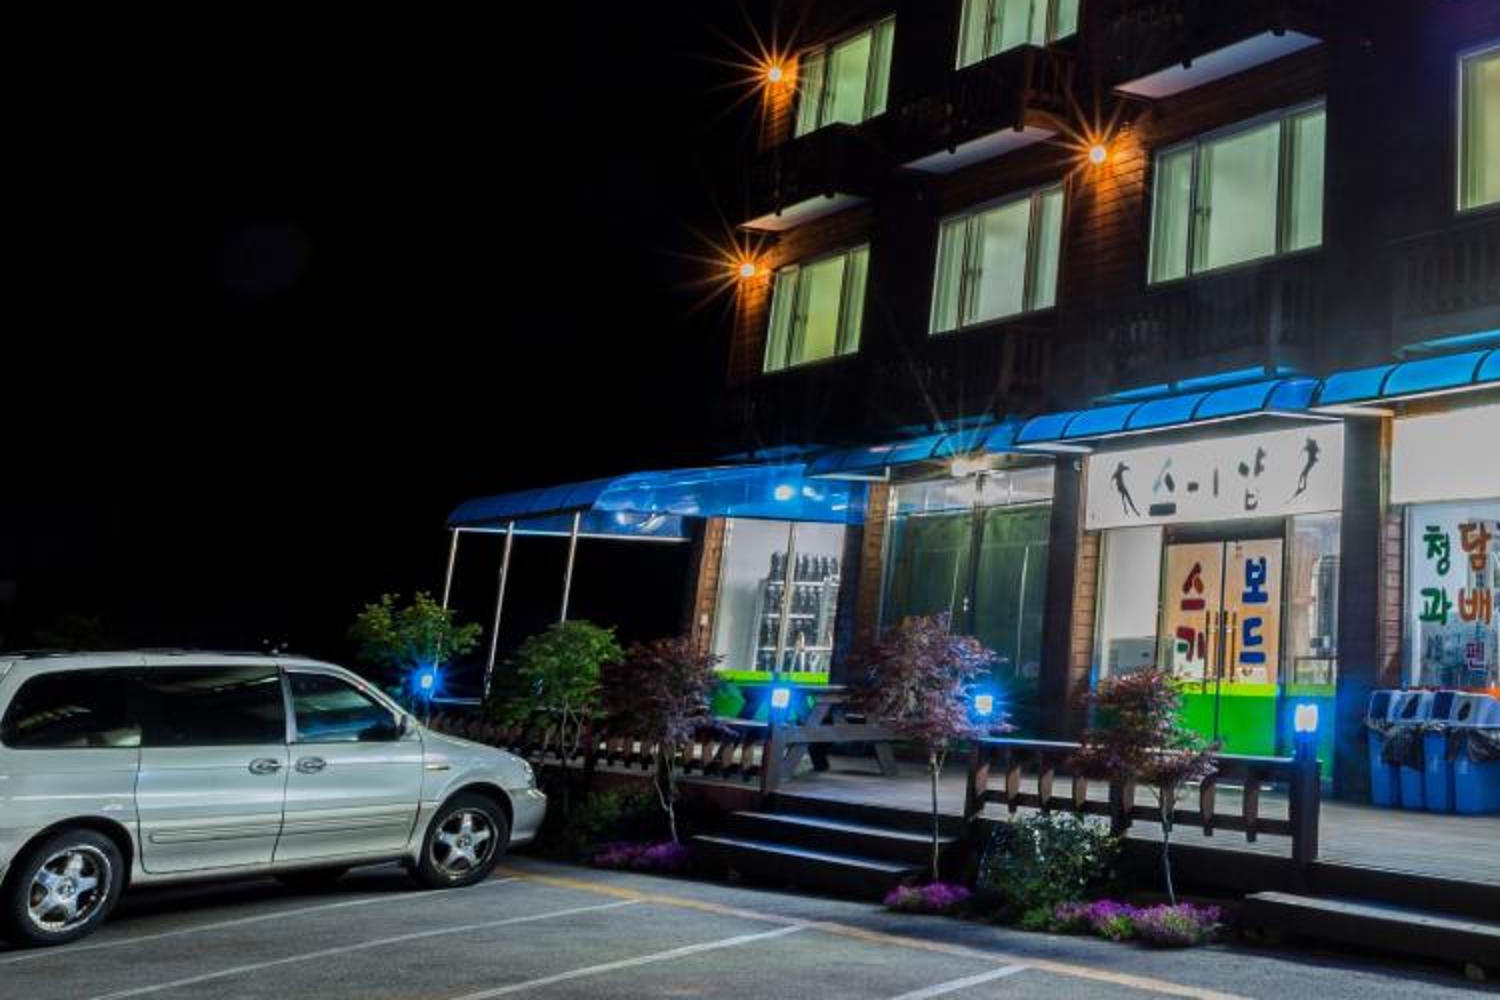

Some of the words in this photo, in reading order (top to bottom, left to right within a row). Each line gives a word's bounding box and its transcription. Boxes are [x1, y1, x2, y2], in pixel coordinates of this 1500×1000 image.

[1176, 562, 1206, 662] 스키
[1239, 556, 1269, 665] 보드
[1420, 525, 1453, 626] 청과
[1458, 521, 1493, 625] 담배
